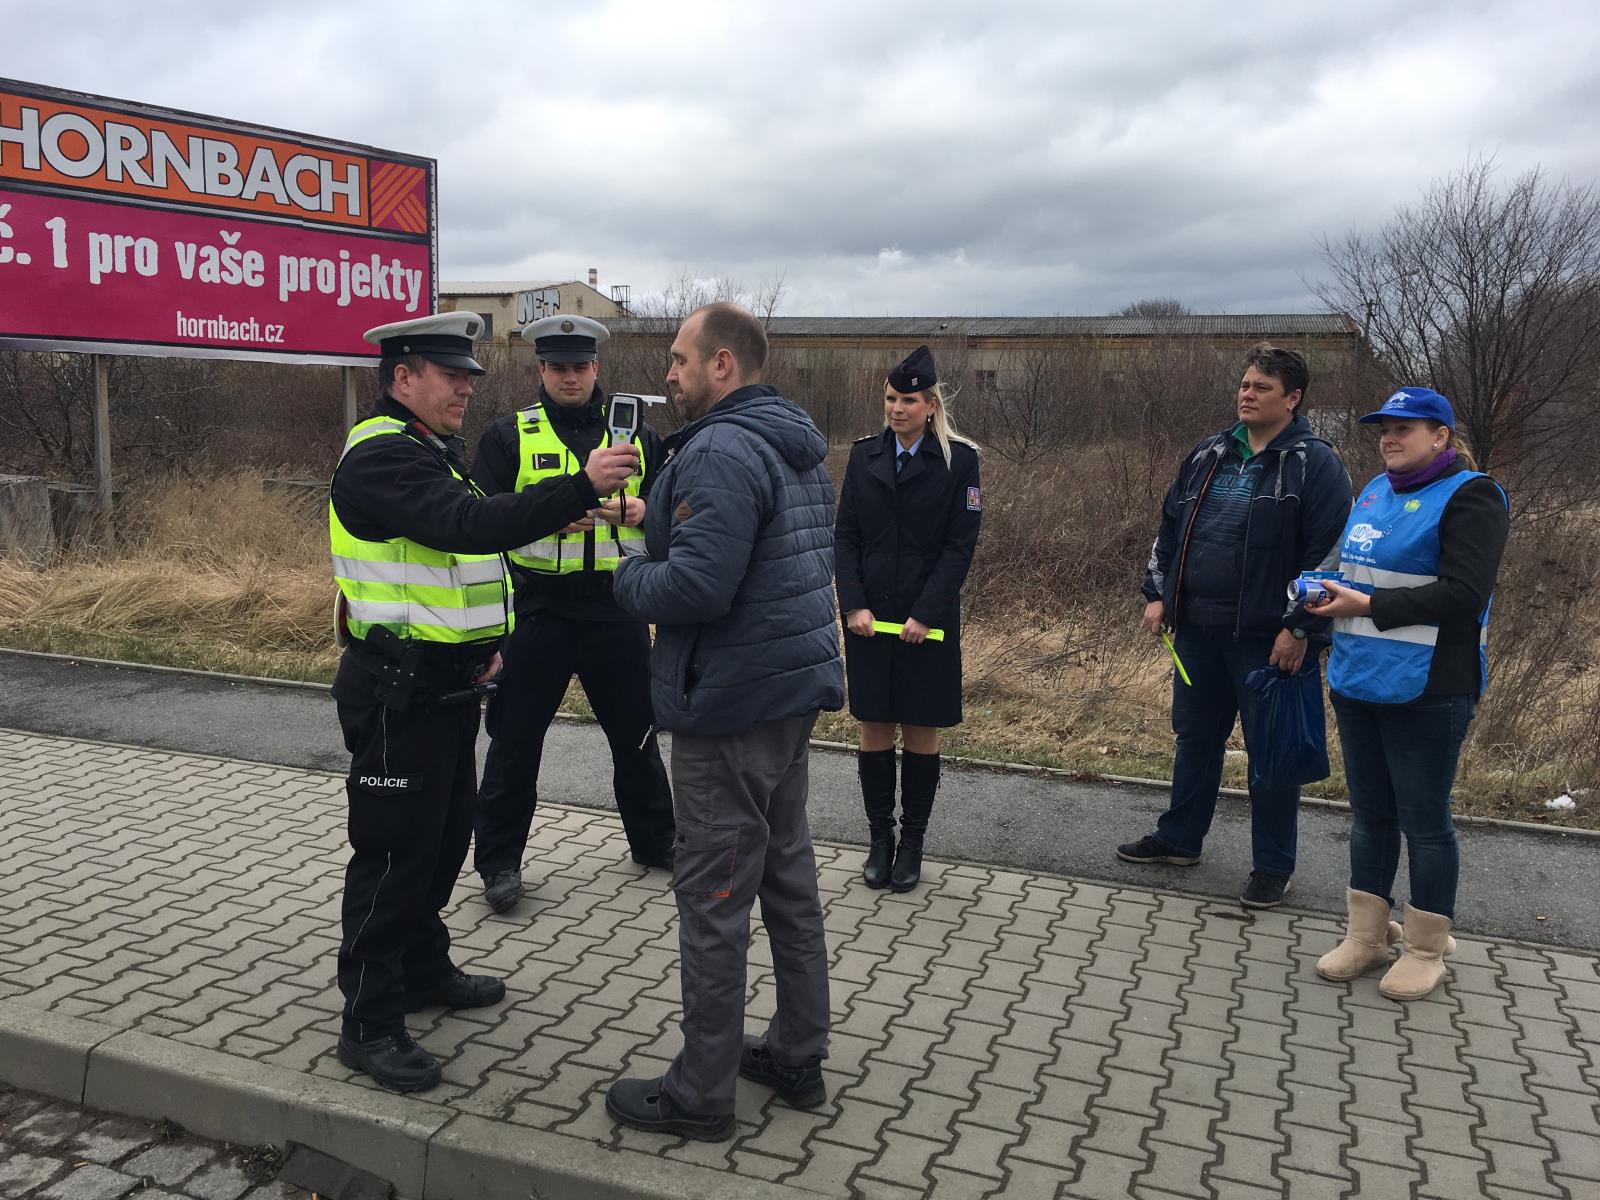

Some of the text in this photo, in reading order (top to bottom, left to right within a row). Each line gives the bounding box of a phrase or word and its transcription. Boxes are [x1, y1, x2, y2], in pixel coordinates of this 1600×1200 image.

[0, 106, 361, 217] HORNBACH
[45, 216, 69, 269] 1
[88, 231, 159, 285] pro
[174, 229, 265, 288] vaše
[278, 248, 423, 313] projekty
[517, 288, 560, 325] NET
[176, 310, 285, 343] hornbach.cz
[359, 776, 409, 788] POLICIE
